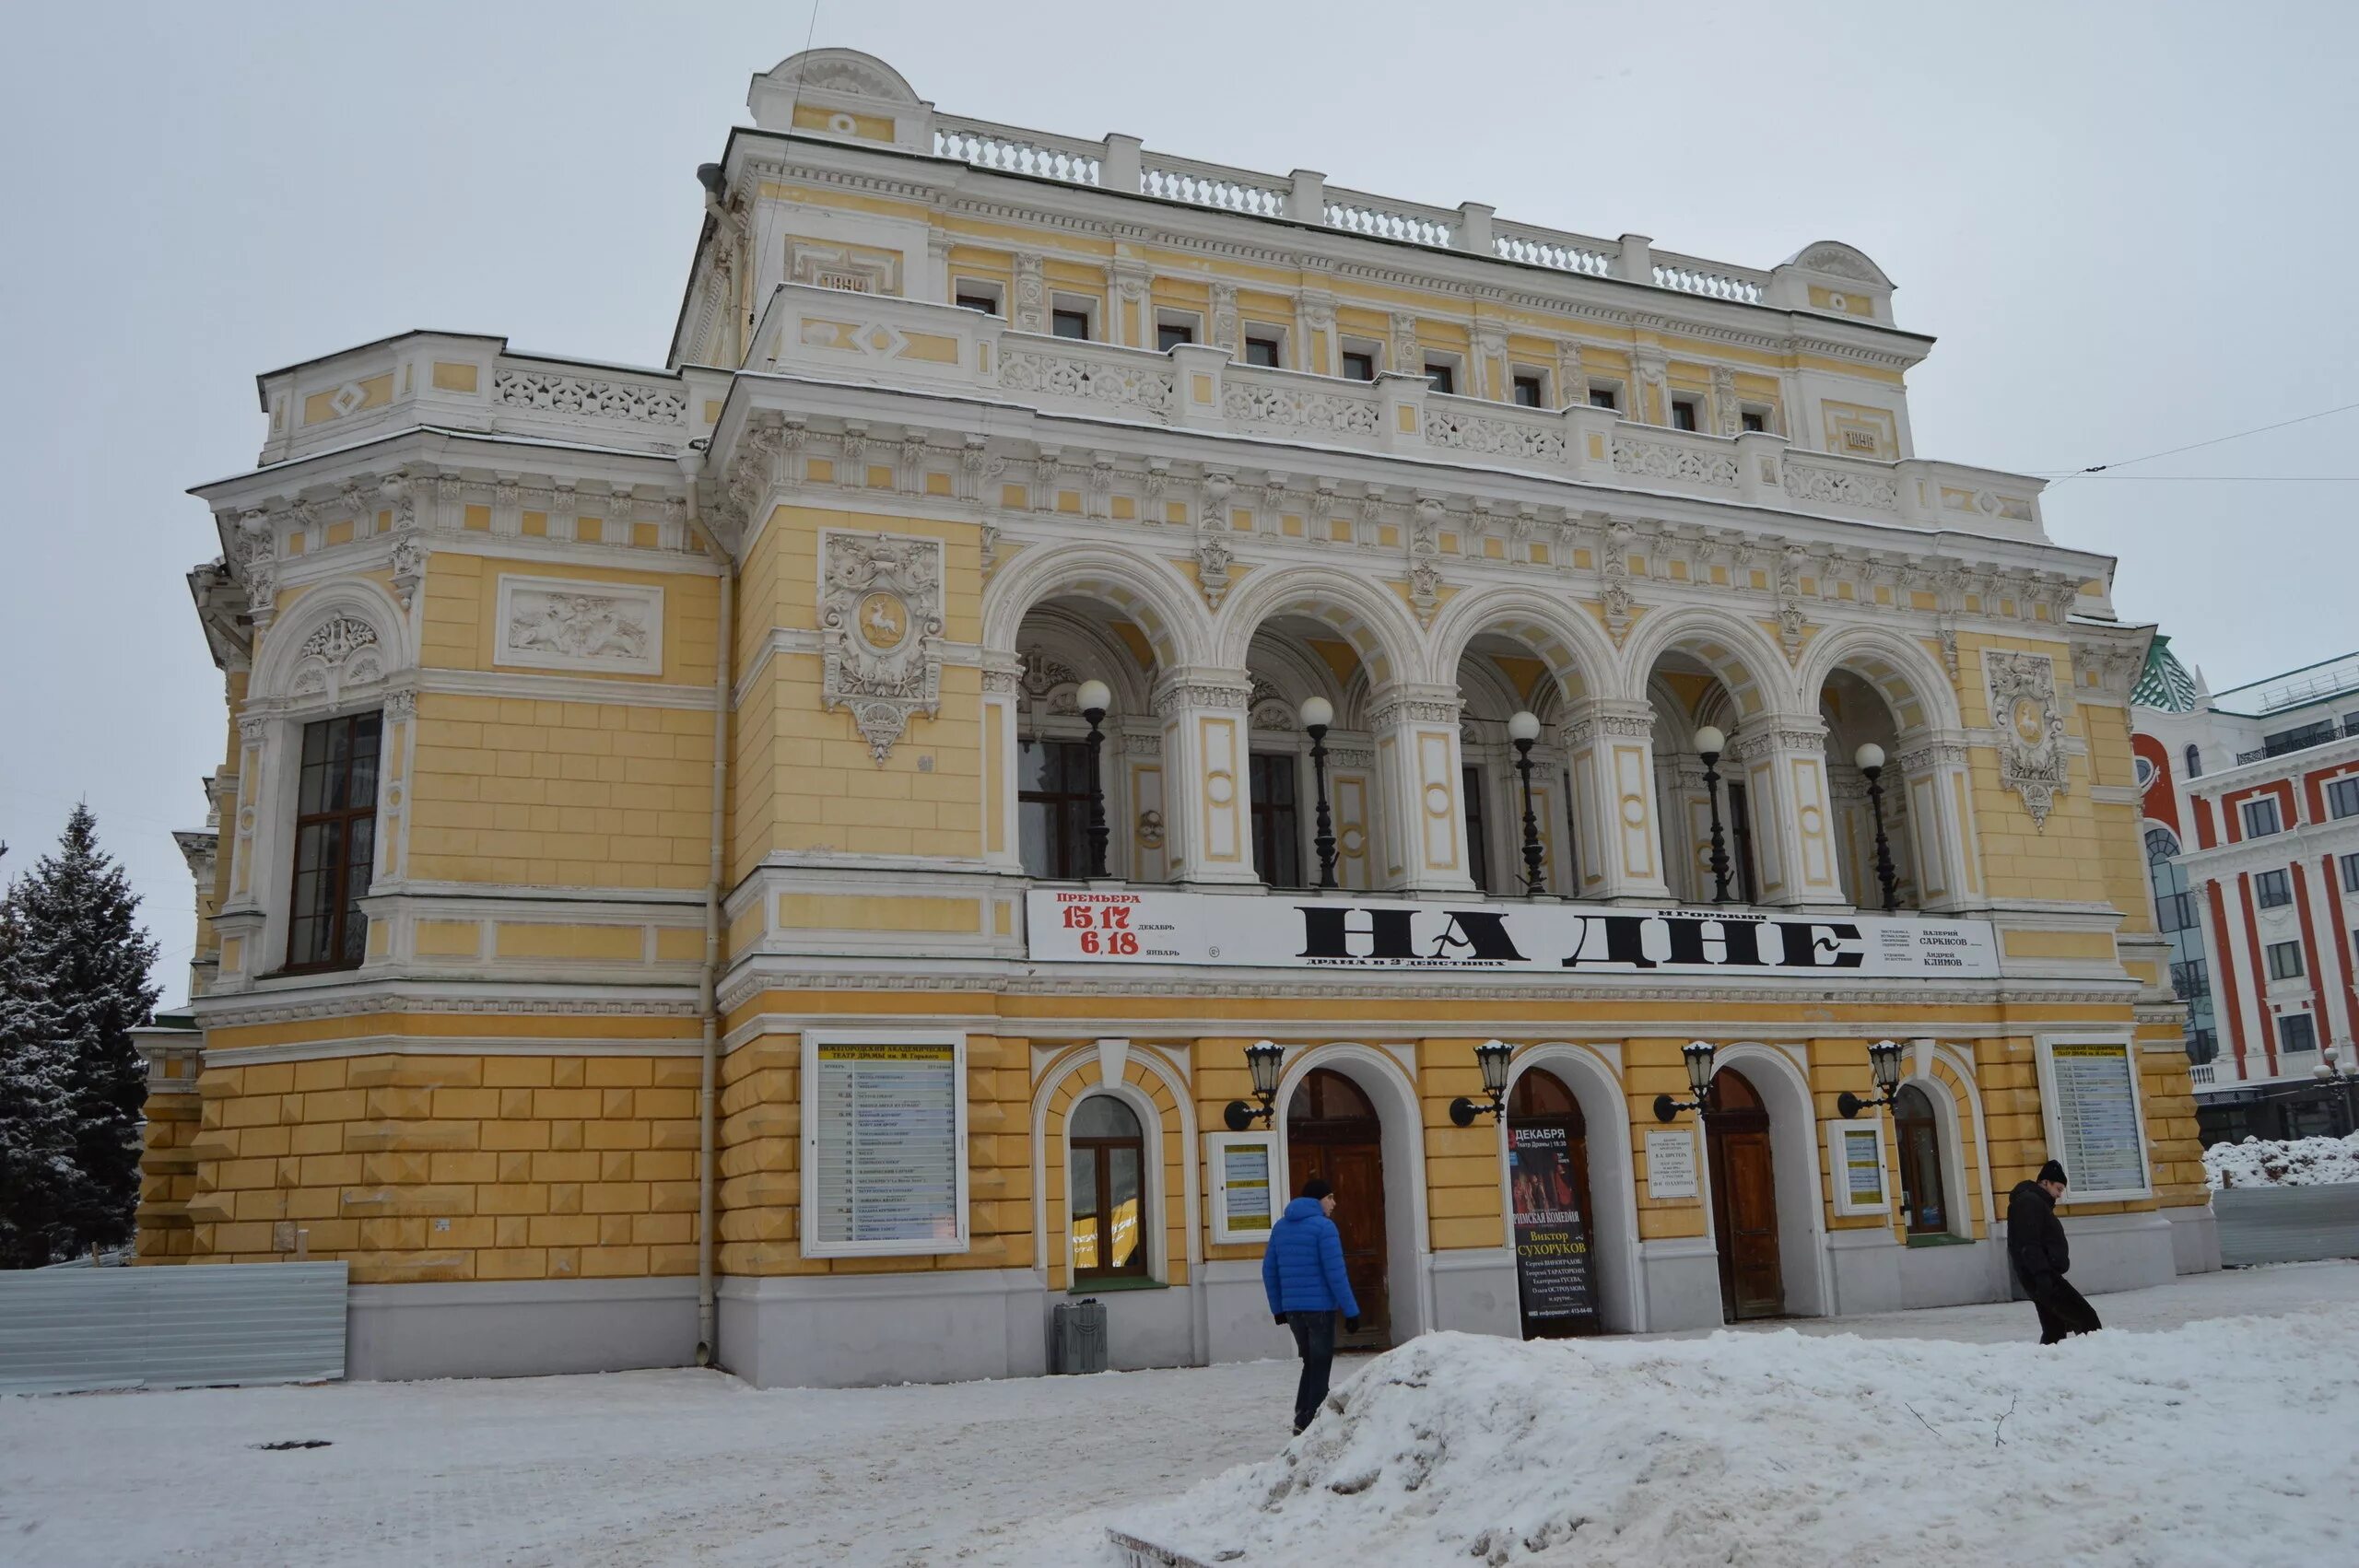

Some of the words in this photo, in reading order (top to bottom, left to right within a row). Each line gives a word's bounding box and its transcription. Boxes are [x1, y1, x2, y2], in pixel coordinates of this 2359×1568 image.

[1056, 893, 1142, 904] ПРЕМЬЕРА
[1293, 907, 1532, 962] НА
[1562, 915, 1863, 968] ДНЕ
[1919, 938, 1967, 946] САРКИСОВ
[1923, 958, 1963, 966] КЛИМОВ
[1515, 1129, 1566, 1141] ДЕКАБРЯ
[1512, 1211, 1546, 1224] РИМСКАЯ
[1530, 1231, 1568, 1242] Виктор
[1518, 1243, 1586, 1257] СУХОРУКОВ
